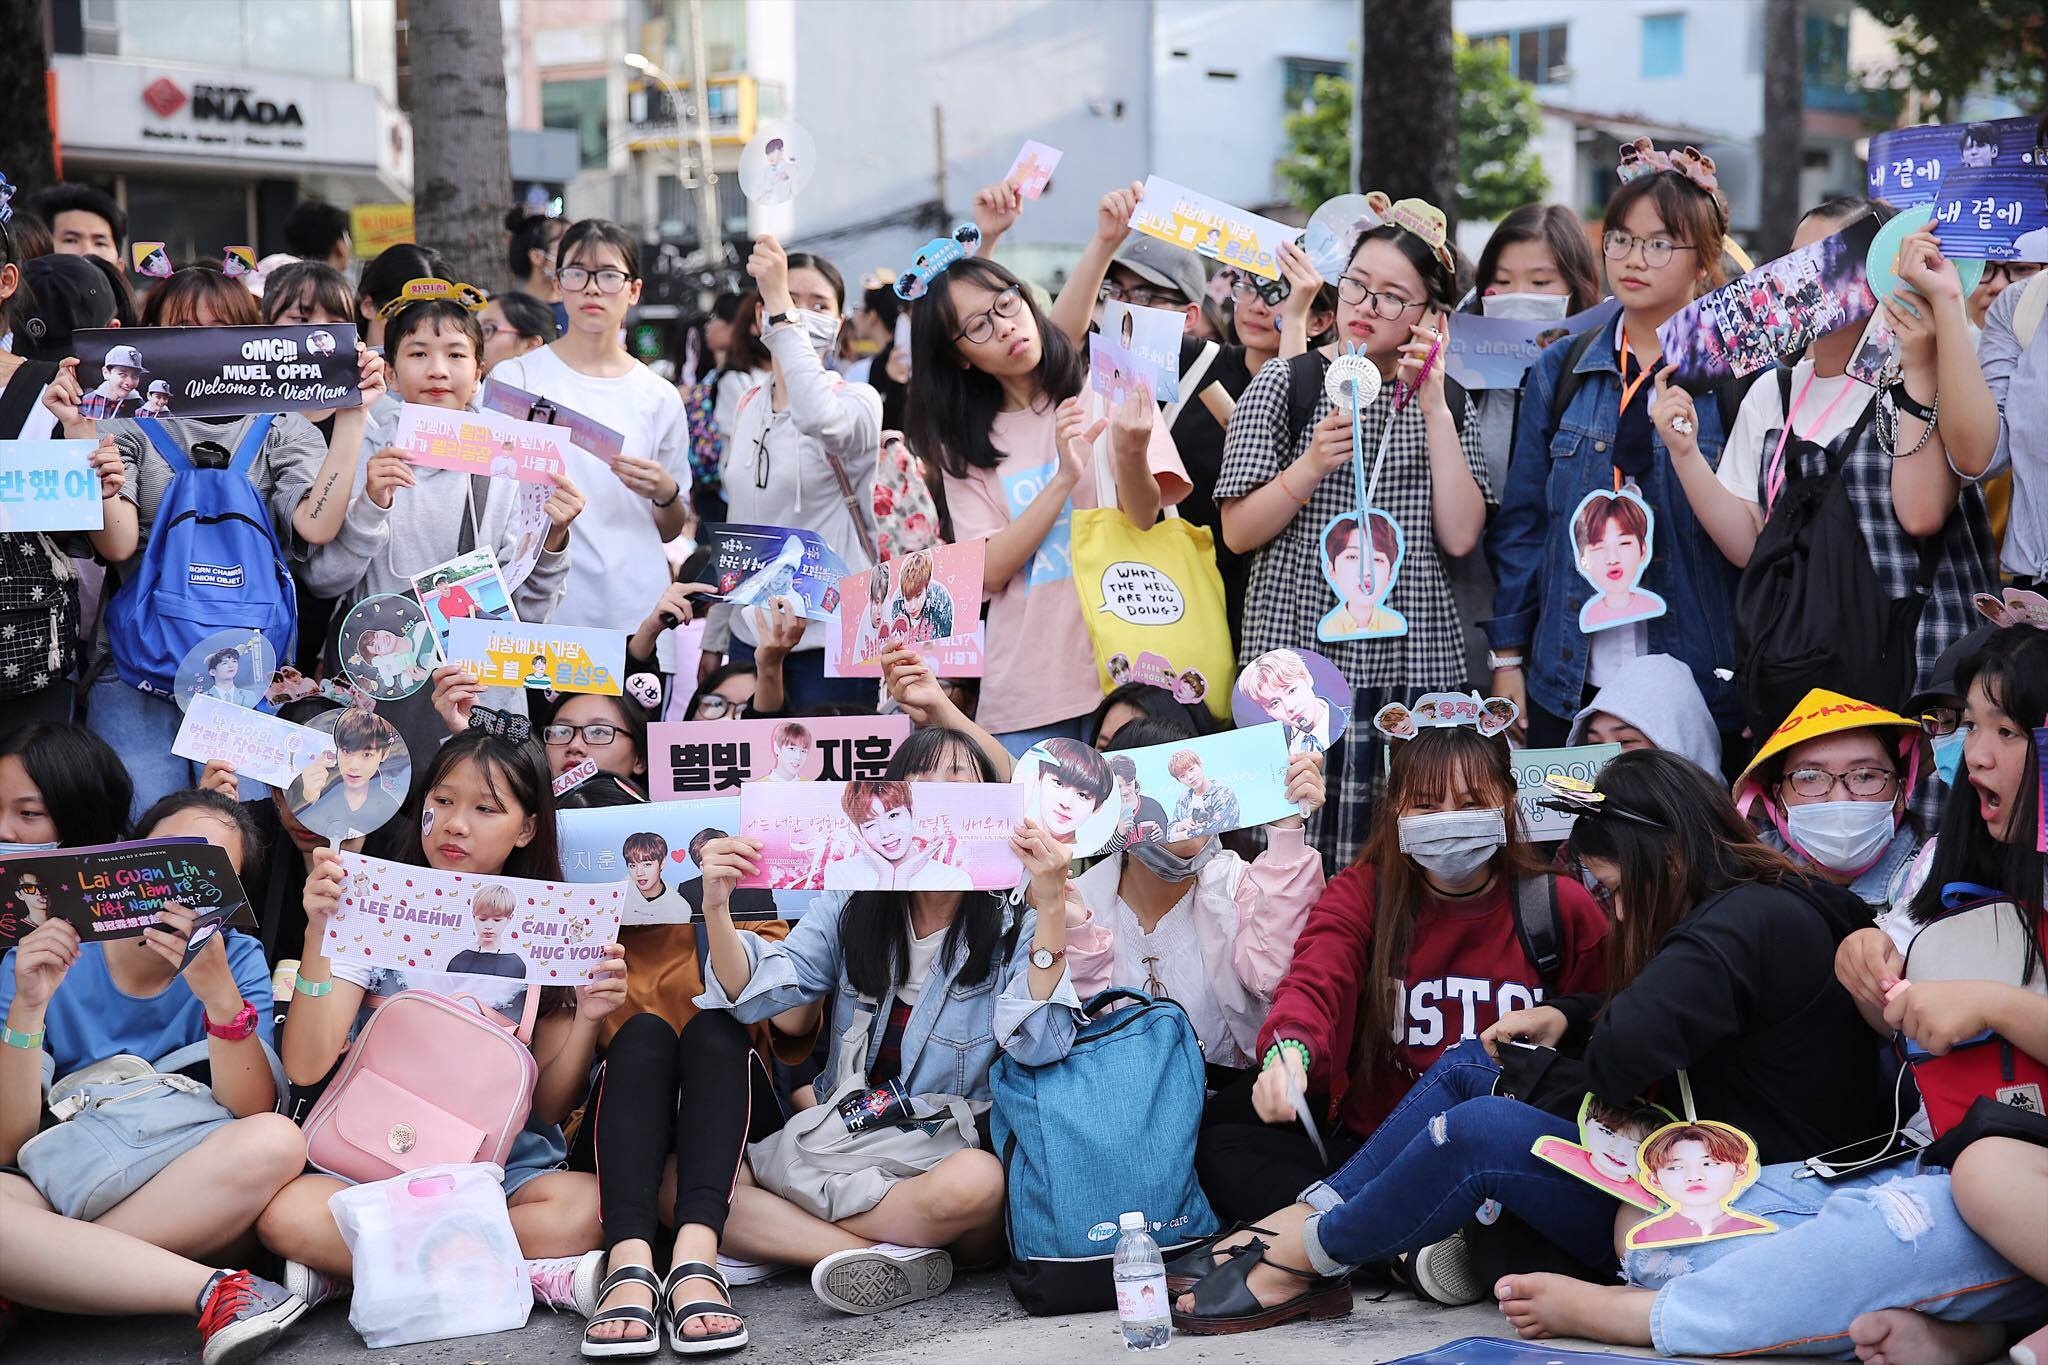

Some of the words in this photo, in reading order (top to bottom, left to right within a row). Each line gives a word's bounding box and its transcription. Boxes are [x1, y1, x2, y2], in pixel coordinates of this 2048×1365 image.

[192, 96, 303, 127] INADA
[1937, 200, 1962, 224] 내
[1972, 197, 2023, 230] 곁에
[241, 338, 298, 362] OMG!!!
[222, 366, 271, 381] MUEL
[276, 363, 322, 380] OPPA
[185, 378, 256, 399] Welcome
[259, 382, 275, 398] to
[0, 470, 96, 502] 반했어
[191, 574, 215, 582] UNION
[1116, 568, 1157, 579] WHAT
[1108, 582, 1135, 592] THE
[1144, 583, 1175, 592] HELL
[1118, 594, 1142, 603] ARE
[1150, 594, 1174, 603] YOU
[1127, 606, 1179, 616] DOING?
[486, 636, 547, 656] 세상에서
[552, 641, 582, 659] 가장
[556, 663, 609, 686] 옹성우
[1438, 701, 1478, 720] 우진
[552, 761, 597, 794] KANG
[670, 742, 751, 792] 별빛
[78, 871, 111, 891] Lai
[167, 860, 200, 879] Lin
[139, 883, 172, 900] làm
[90, 902, 125, 919] Việt
[130, 899, 164, 913] Nam
[359, 898, 389, 918] LEE
[392, 903, 463, 928] DAEHWI
[521, 920, 559, 937] CAN
[560, 923, 569, 938] I
[529, 945, 565, 960] HUG
[1090, 1226, 1117, 1241] Pfizer
[1169, 1215, 1189, 1228] care
